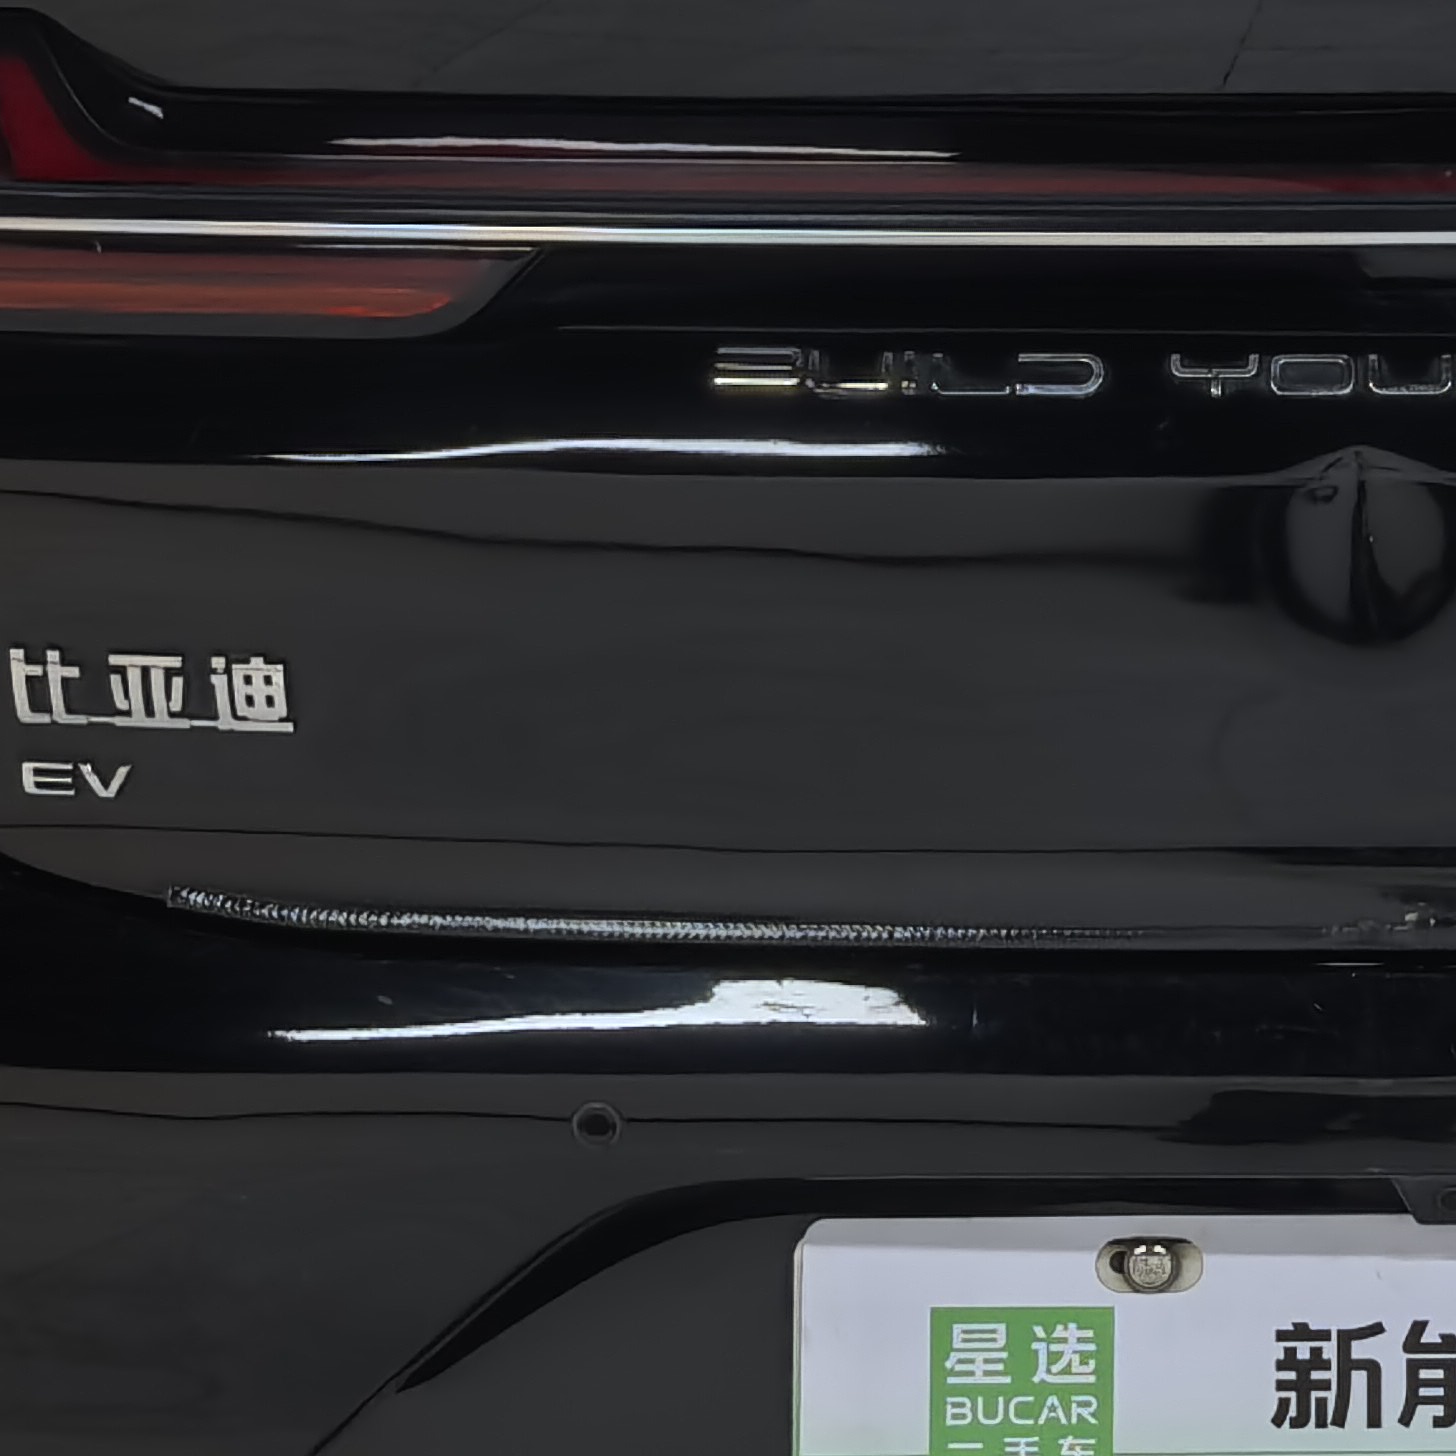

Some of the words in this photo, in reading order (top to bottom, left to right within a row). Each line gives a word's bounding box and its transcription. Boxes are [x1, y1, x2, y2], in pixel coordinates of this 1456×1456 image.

[712, 346, 1106, 397] BUILD
[9, 648, 294, 732] 比亚迪
[22, 761, 133, 798] EV
[945, 1322, 1098, 1384] 星选
[945, 1395, 1099, 1426] BUCAR
